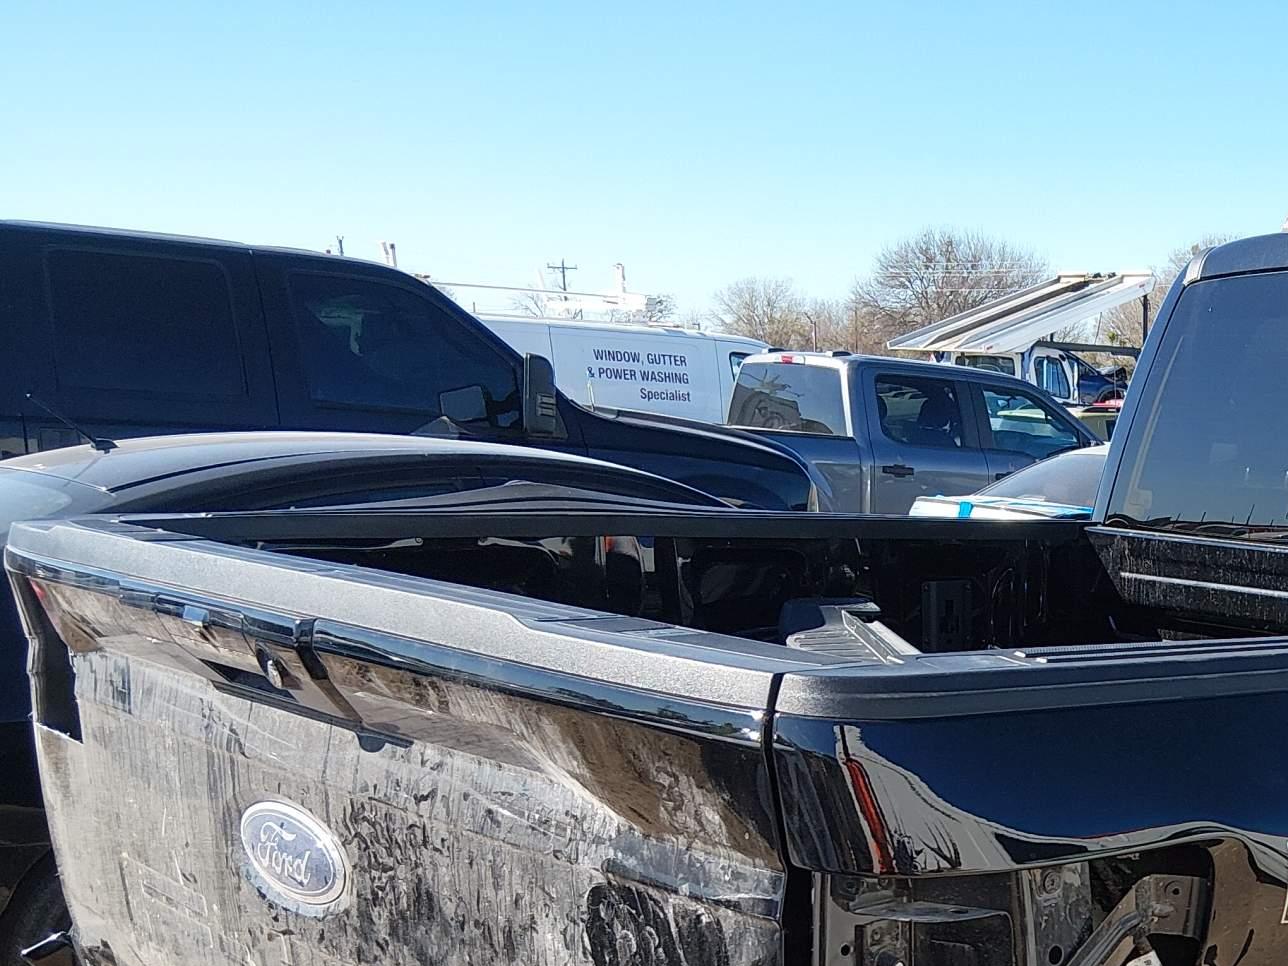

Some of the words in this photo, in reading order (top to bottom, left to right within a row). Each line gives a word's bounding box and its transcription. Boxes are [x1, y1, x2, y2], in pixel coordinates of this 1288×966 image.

[593, 349, 644, 366] WINDOW,
[647, 353, 687, 367] GUTTER
[587, 366, 595, 378] &
[598, 367, 637, 381] POWER
[639, 370, 689, 385] WASHING
[640, 388, 691, 402] Specialist
[257, 821, 311, 886] Ford
